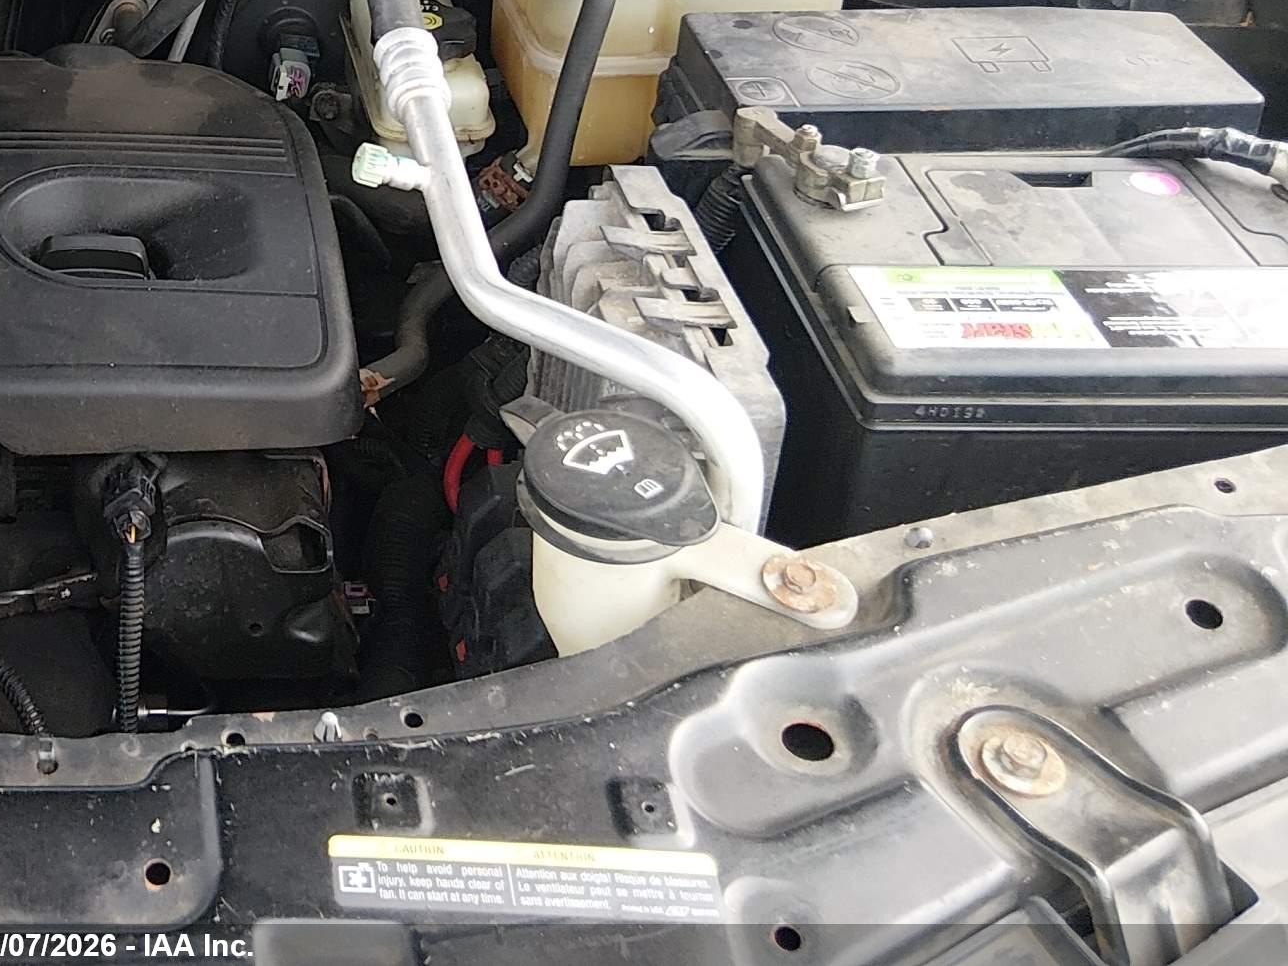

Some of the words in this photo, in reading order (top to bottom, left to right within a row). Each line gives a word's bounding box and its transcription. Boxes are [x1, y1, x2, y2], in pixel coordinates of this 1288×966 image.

[395, 844, 444, 854] CAUTION
[377, 861, 387, 872] To
[397, 862, 417, 875] help
[426, 863, 452, 875] avoid
[461, 865, 503, 878] personal
[516, 868, 557, 880] Attention
[560, 872, 577, 881] aux
[581, 872, 610, 884] doigts!
[615, 873, 646, 886] Risque
[650, 875, 661, 886] de
[410, 877, 432, 889] keep
[437, 878, 464, 889] hands
[468, 879, 490, 890] clear
[495, 880, 504, 890] of
[518, 882, 530, 892] Le
[536, 883, 584, 894] ventilateur
[590, 886, 611, 896] peut
[616, 888, 628, 896] se
[633, 888, 663, 899] mettre
[380, 888, 397, 899] fan.
[399, 890, 406, 899] It
[408, 891, 424, 900] can
[427, 892, 448, 902] start
[450, 893, 460, 902] at
[463, 894, 478, 904] any
[481, 894, 504, 904] time.
[520, 896, 542, 906] sans
[545, 897, 609, 910] avertissement.
